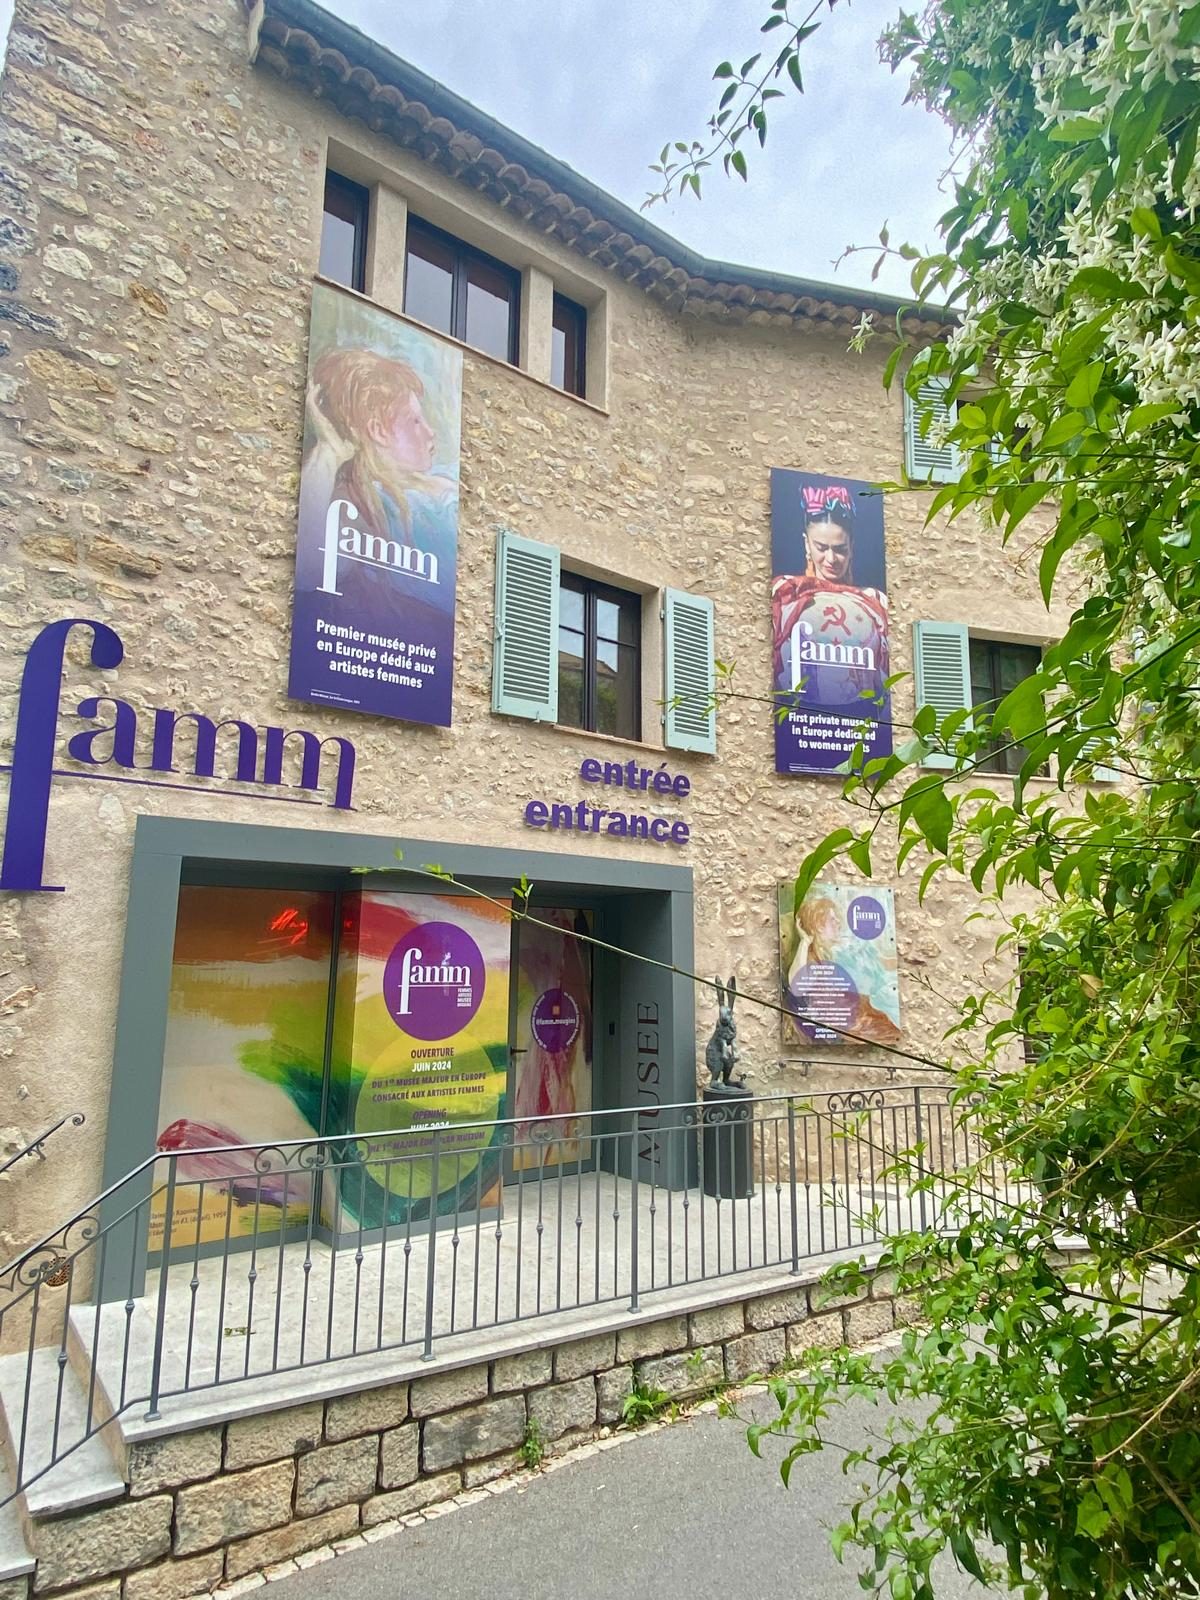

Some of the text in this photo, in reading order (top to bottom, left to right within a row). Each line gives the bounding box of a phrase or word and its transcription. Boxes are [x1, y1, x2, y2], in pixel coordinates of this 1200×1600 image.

[316, 499, 441, 596] famm
[316, 618, 437, 660] Premier musée privé
[316, 640, 435, 675] en Europe dédié aux
[787, 620, 877, 693] famm
[329, 659, 423, 689] artistes femmes
[788, 712, 808, 723] First
[809, 714, 840, 726] private
[792, 725, 876, 741] in Europe dedicaed
[799, 739, 870, 753] to women artts
[0, 618, 358, 892] famm
[580, 758, 691, 797] entrée
[525, 799, 690, 845] entrance
[853, 905, 880, 930] famm
[396, 947, 472, 1015] famm
[411, 1047, 455, 1059] OUVERTURE
[411, 1061, 452, 1072] JUIN 2024
[372, 1080, 383, 1089] DU
[422, 1075, 450, 1084] MAJEUR
[451, 1074, 460, 1082] EN
[461, 1072, 487, 1081] EUROPE
[372, 1085, 485, 1103] CONSACRÉ AUX ARTISTES FEMMES
[413, 1108, 448, 1120] OPENING
